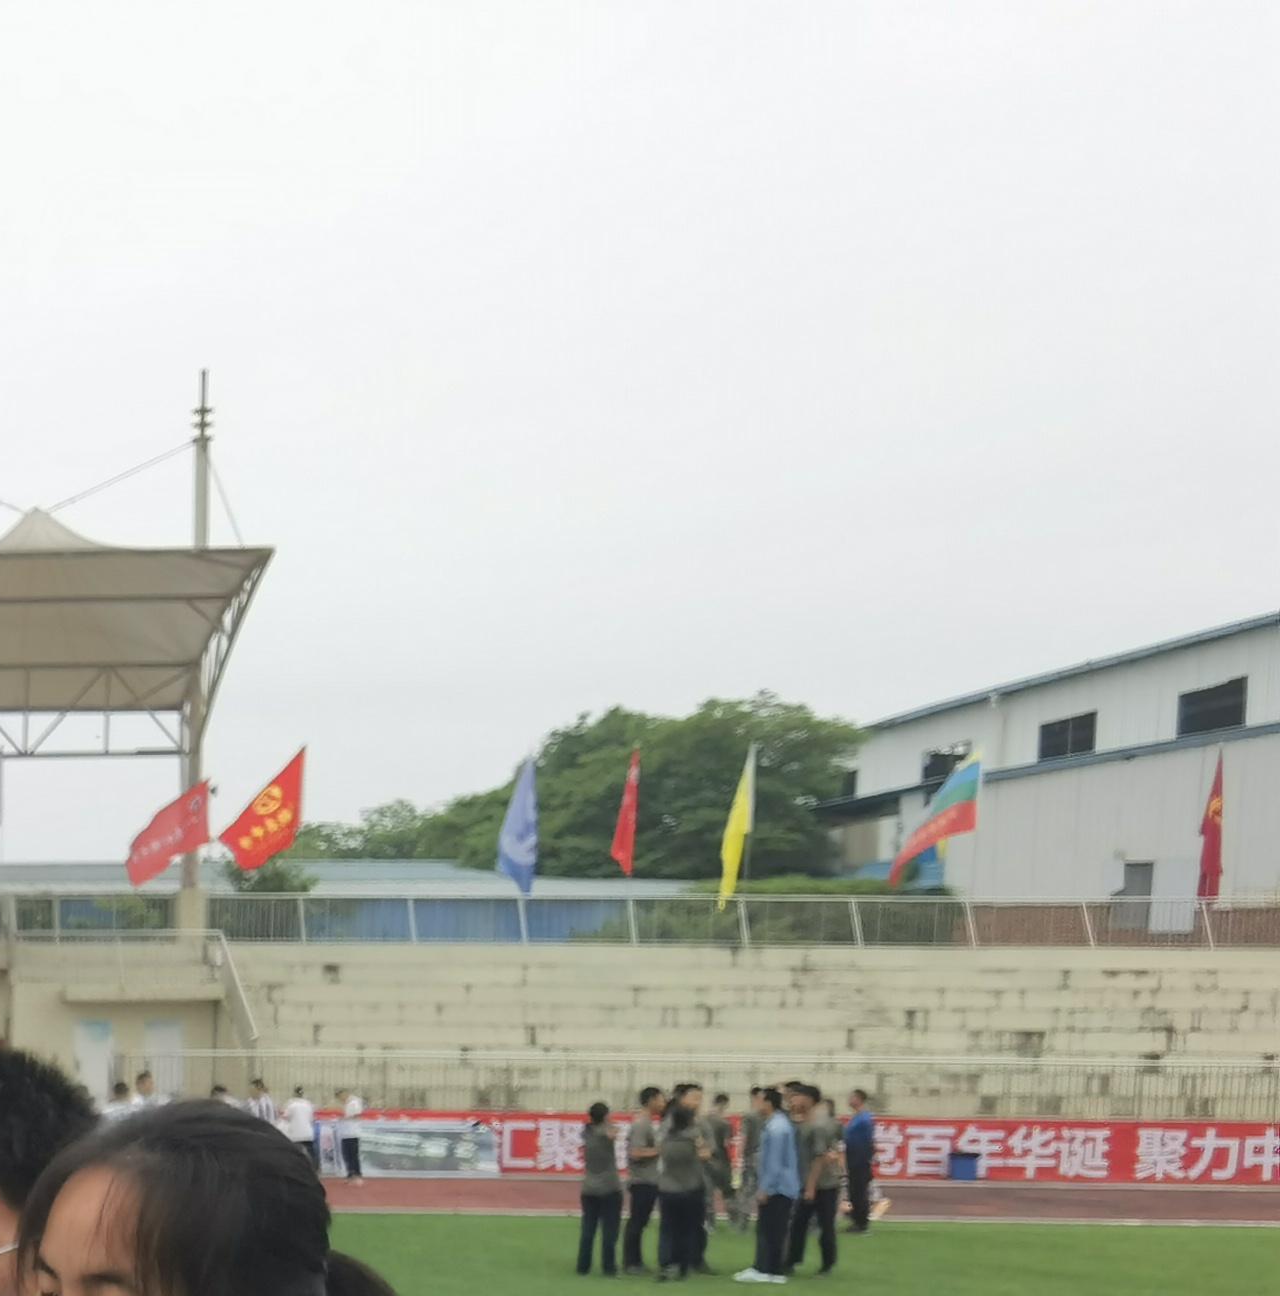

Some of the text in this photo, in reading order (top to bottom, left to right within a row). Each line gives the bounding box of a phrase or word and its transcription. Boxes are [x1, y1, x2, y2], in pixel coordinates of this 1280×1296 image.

[874, 1123, 1280, 1182] 党百年华诞 聚力中
